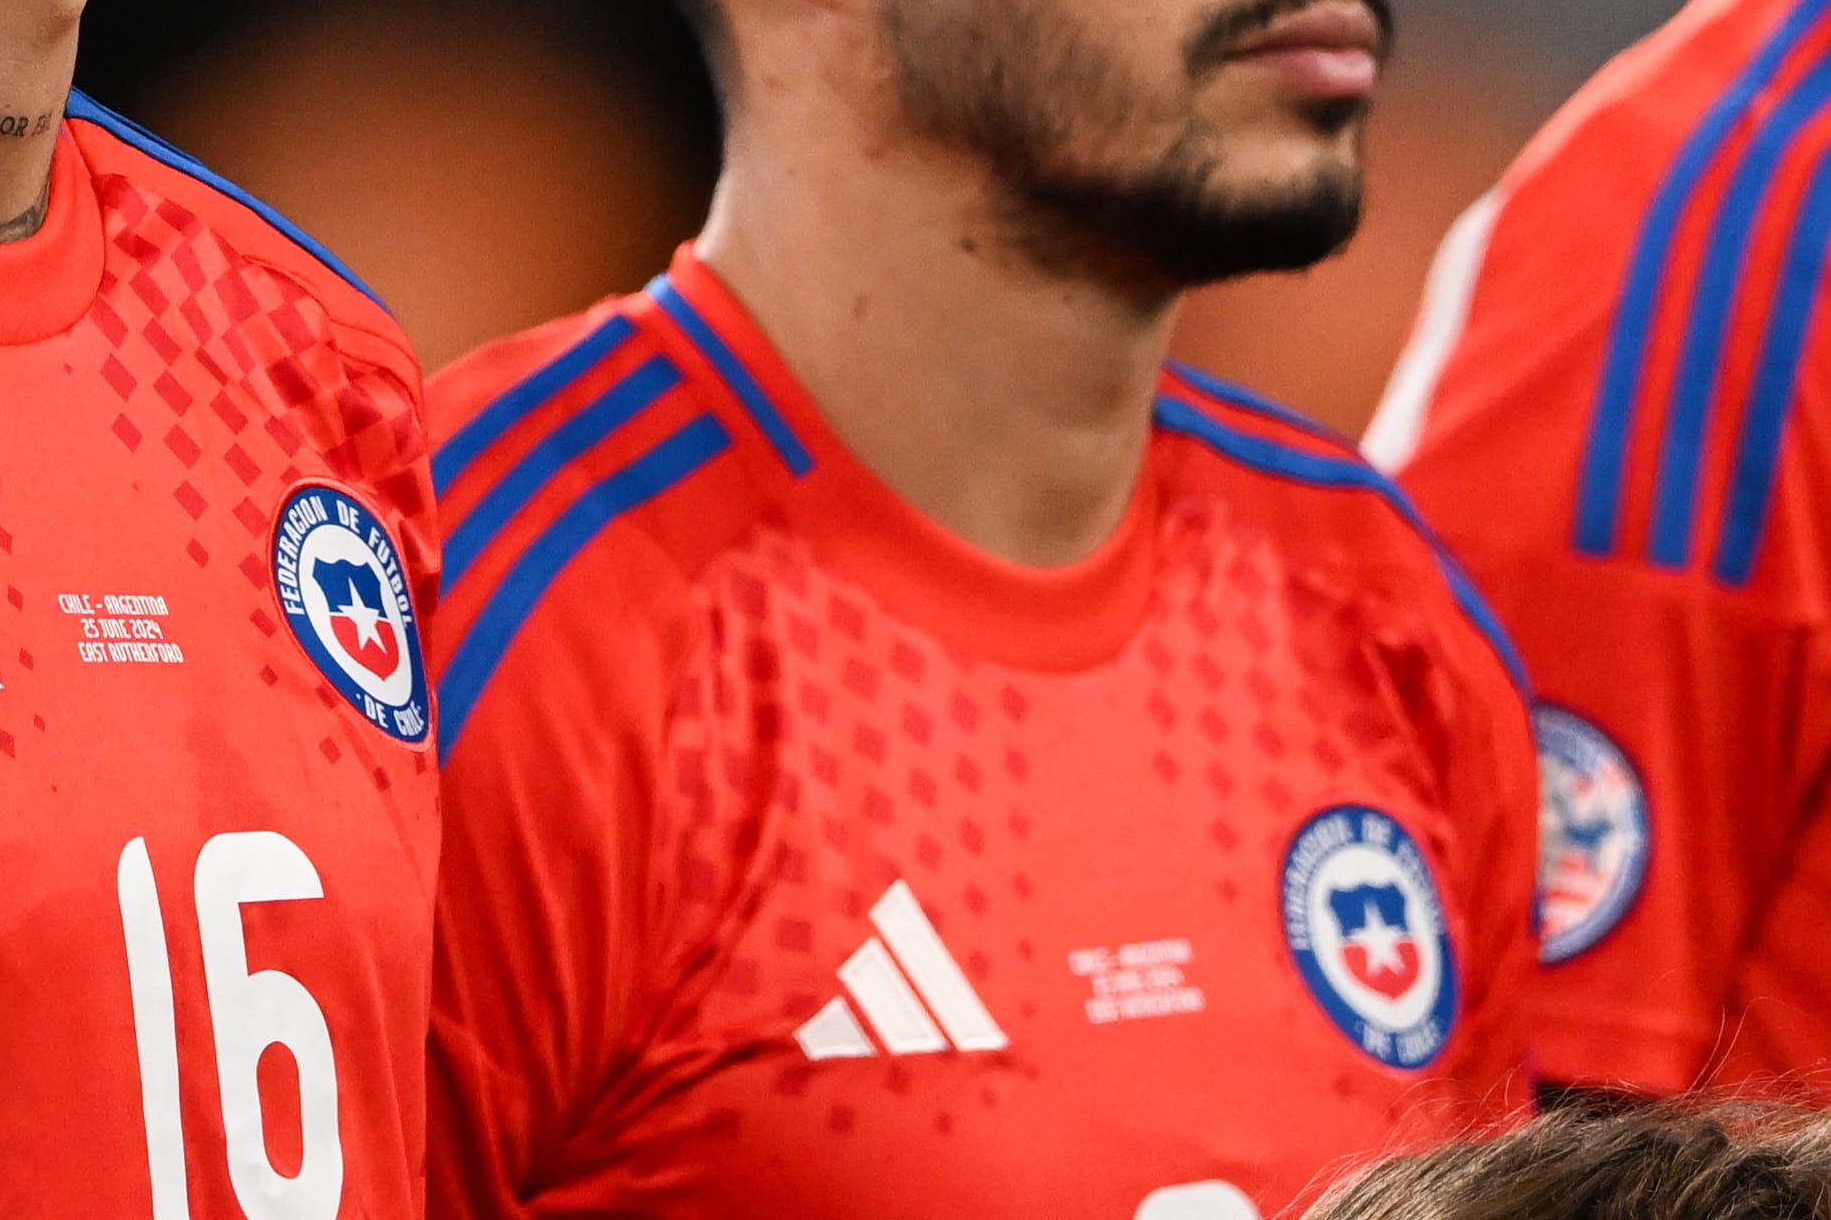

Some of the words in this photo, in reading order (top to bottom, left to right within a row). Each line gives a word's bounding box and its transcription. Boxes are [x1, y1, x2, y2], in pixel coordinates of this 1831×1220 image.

[275, 495, 329, 616] FEDERACION
[336, 499, 361, 534] DE
[367, 526, 413, 629] FUTBOL
[58, 593, 96, 614] CHILE
[103, 594, 170, 616] ARGENTINA
[81, 617, 100, 639] 25
[98, 618, 132, 639] JUNE
[129, 619, 164, 640] 2024
[77, 641, 109, 663] EAST
[107, 641, 185, 664] RUTHERFORD
[363, 693, 390, 730] DE
[117, 830, 344, 1220] 16
